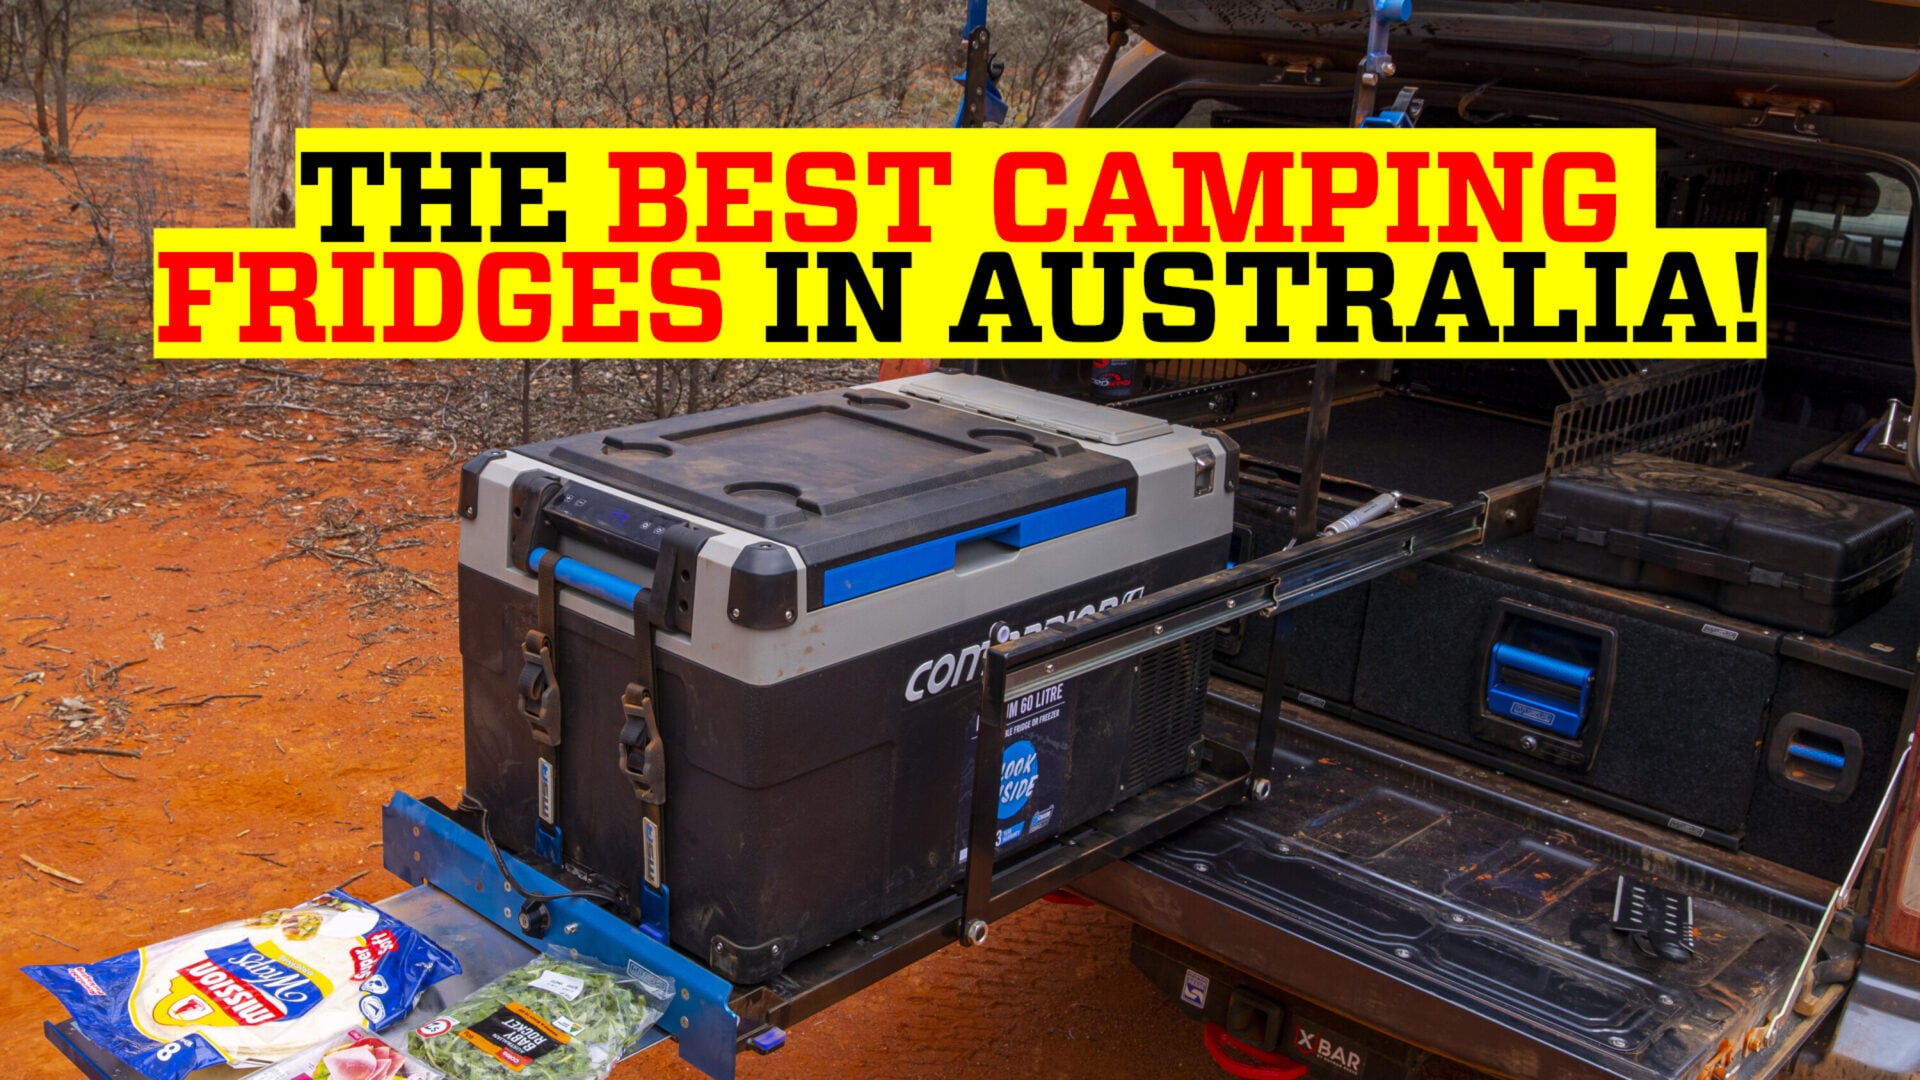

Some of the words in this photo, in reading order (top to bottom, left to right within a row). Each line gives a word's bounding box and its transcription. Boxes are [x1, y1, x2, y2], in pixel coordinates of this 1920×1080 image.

[1020, 695, 1033, 714] 60
[1036, 683, 1064, 708] LITRE
[1013, 720, 1031, 734] FRIDGE
[1039, 709, 1059, 723] FREEZER
[999, 774, 1039, 803] SIDE
[371, 932, 394, 955] Soft
[227, 952, 310, 1003] Wraps
[354, 948, 374, 979] Super
[501, 1018, 548, 1045] ROCKET
[503, 1031, 537, 1052] BABY
[155, 1041, 181, 1062] 8
[1298, 1029, 1315, 1050] X
[1318, 1038, 1360, 1071] BAR
